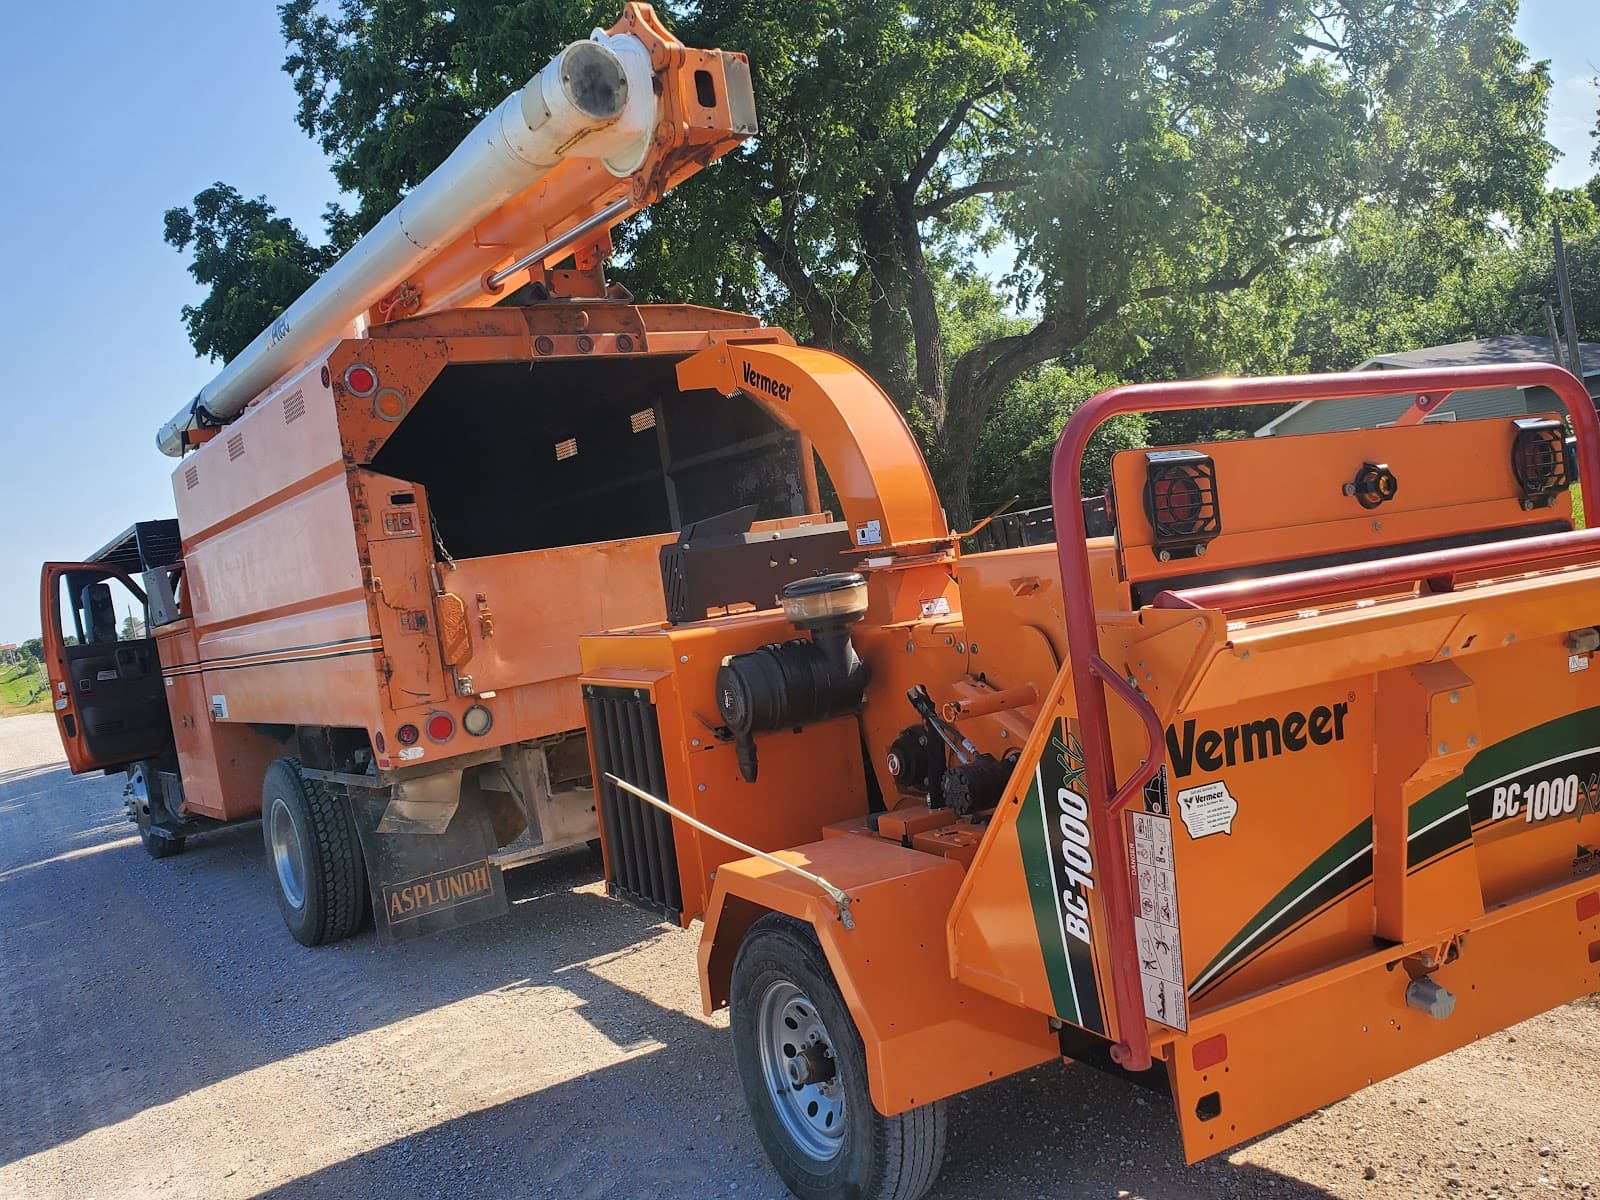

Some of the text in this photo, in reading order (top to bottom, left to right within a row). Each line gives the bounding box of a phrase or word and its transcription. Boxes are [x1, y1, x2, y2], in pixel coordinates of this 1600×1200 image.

[742, 360, 791, 402] Vermeer
[1165, 701, 1348, 778] Vermeer
[1194, 791, 1224, 804] Vermeer
[391, 867, 489, 917] ASPLUNDH
